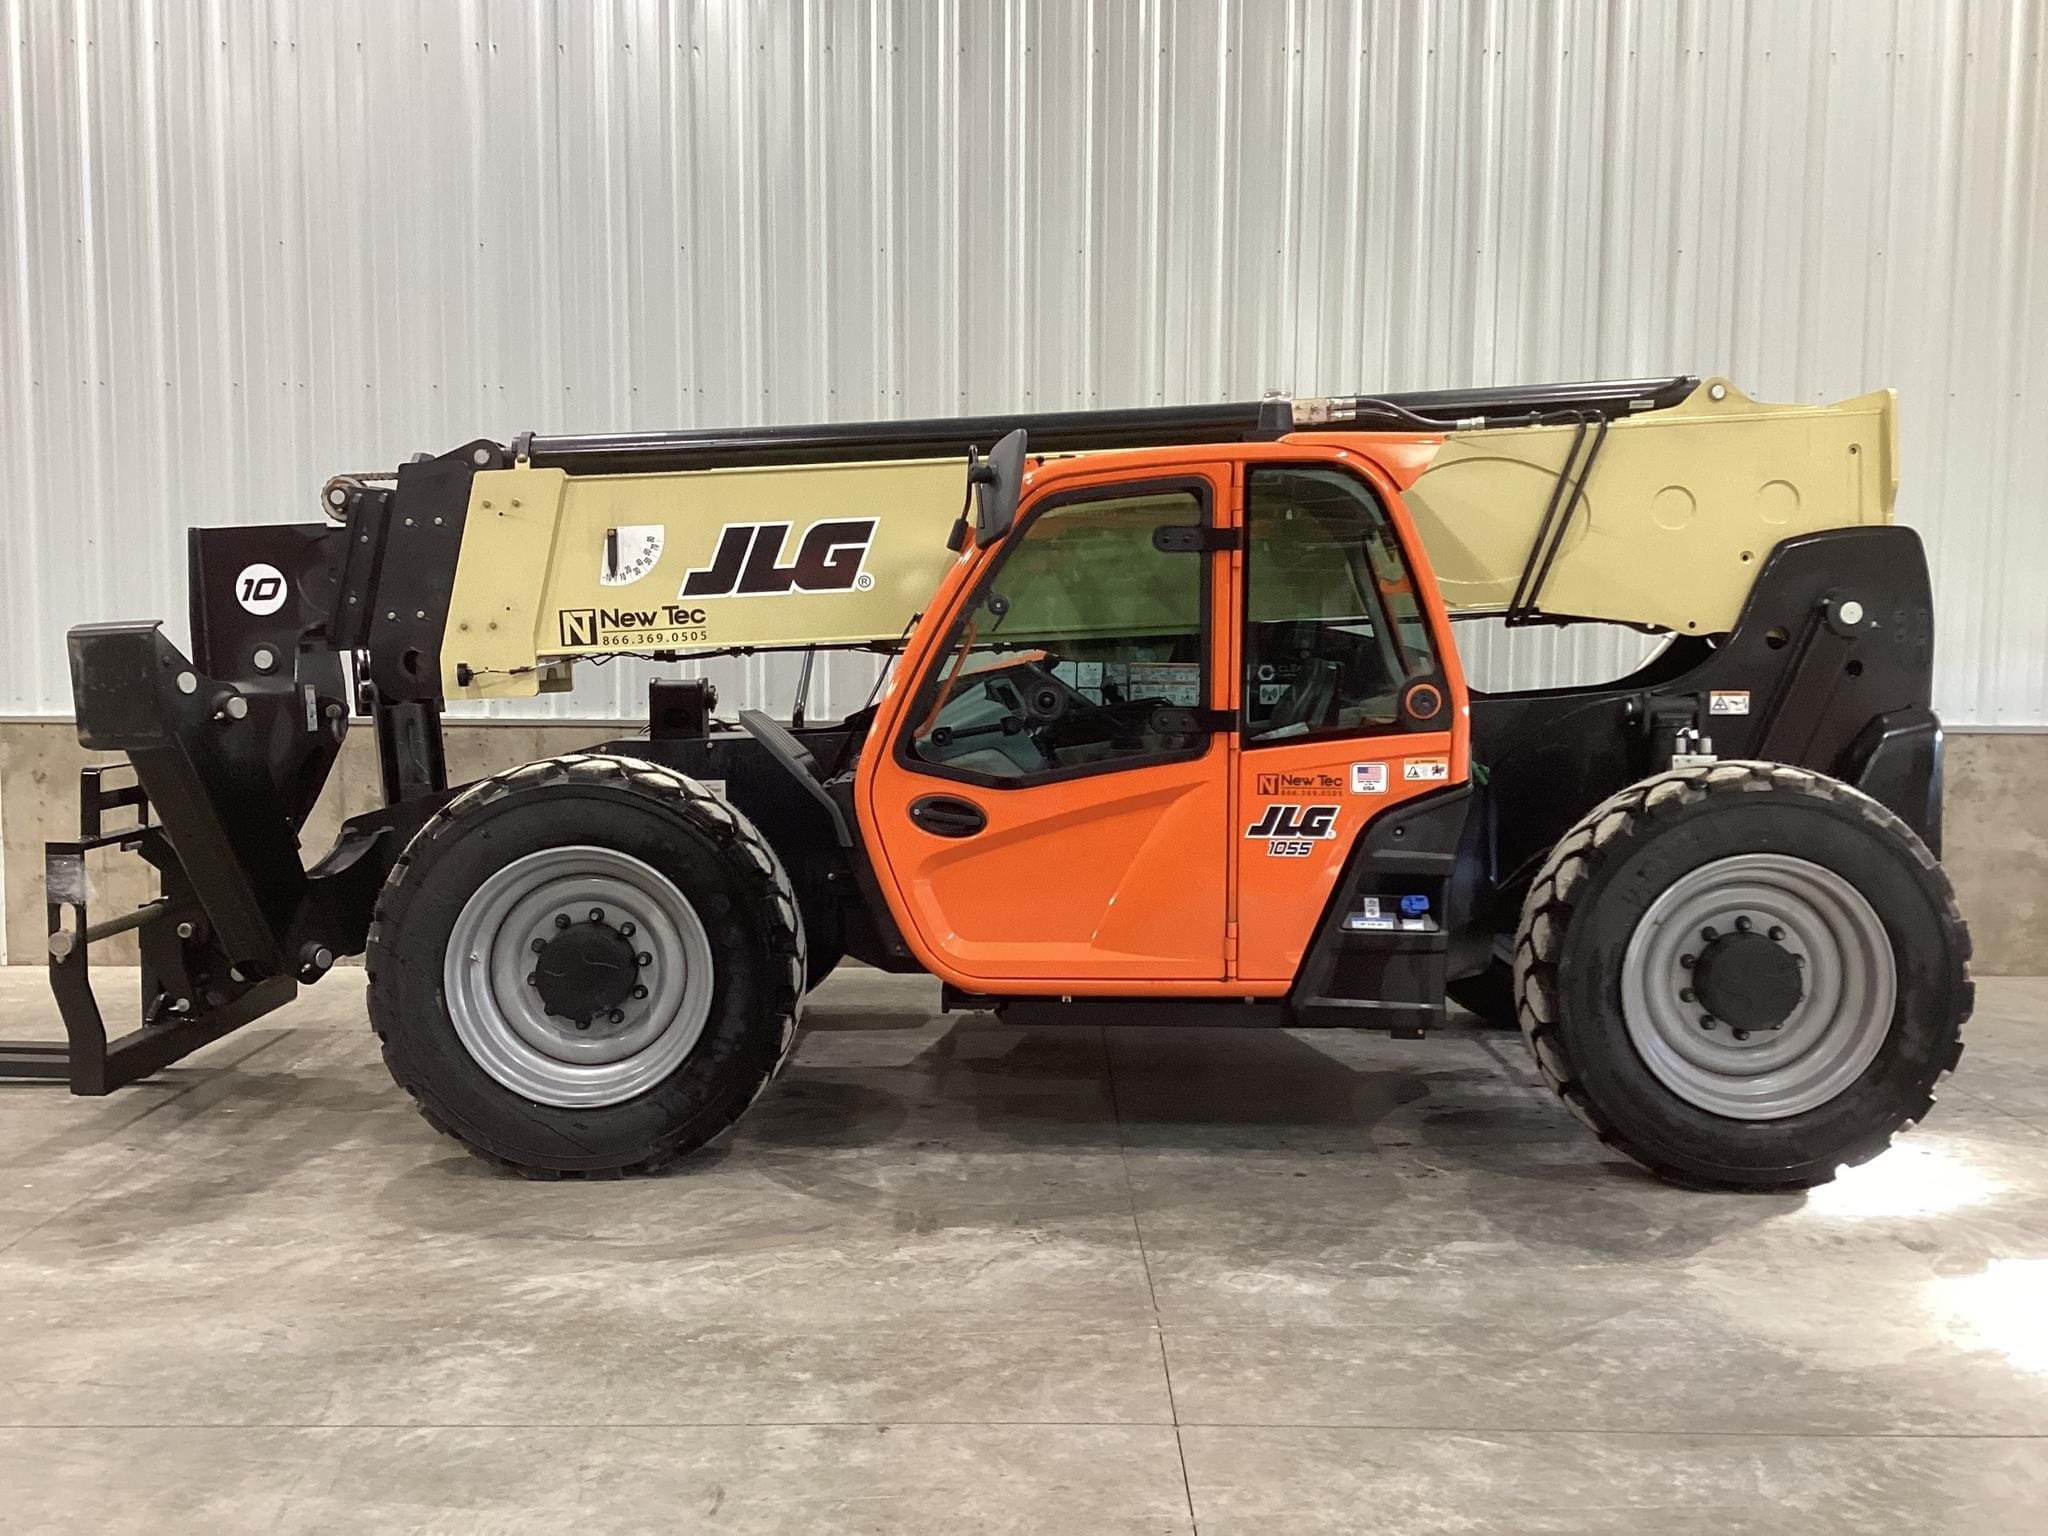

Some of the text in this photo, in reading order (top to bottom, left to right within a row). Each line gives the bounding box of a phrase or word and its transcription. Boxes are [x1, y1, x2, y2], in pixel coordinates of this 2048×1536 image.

[241, 577, 282, 602] 10
[600, 608, 657, 629] New
[661, 605, 706, 626] Tec
[602, 631, 707, 646] 866.369.0505
[1281, 774, 1315, 786] New
[1317, 774, 1344, 787] Tec
[1268, 841, 1313, 855] 1055
